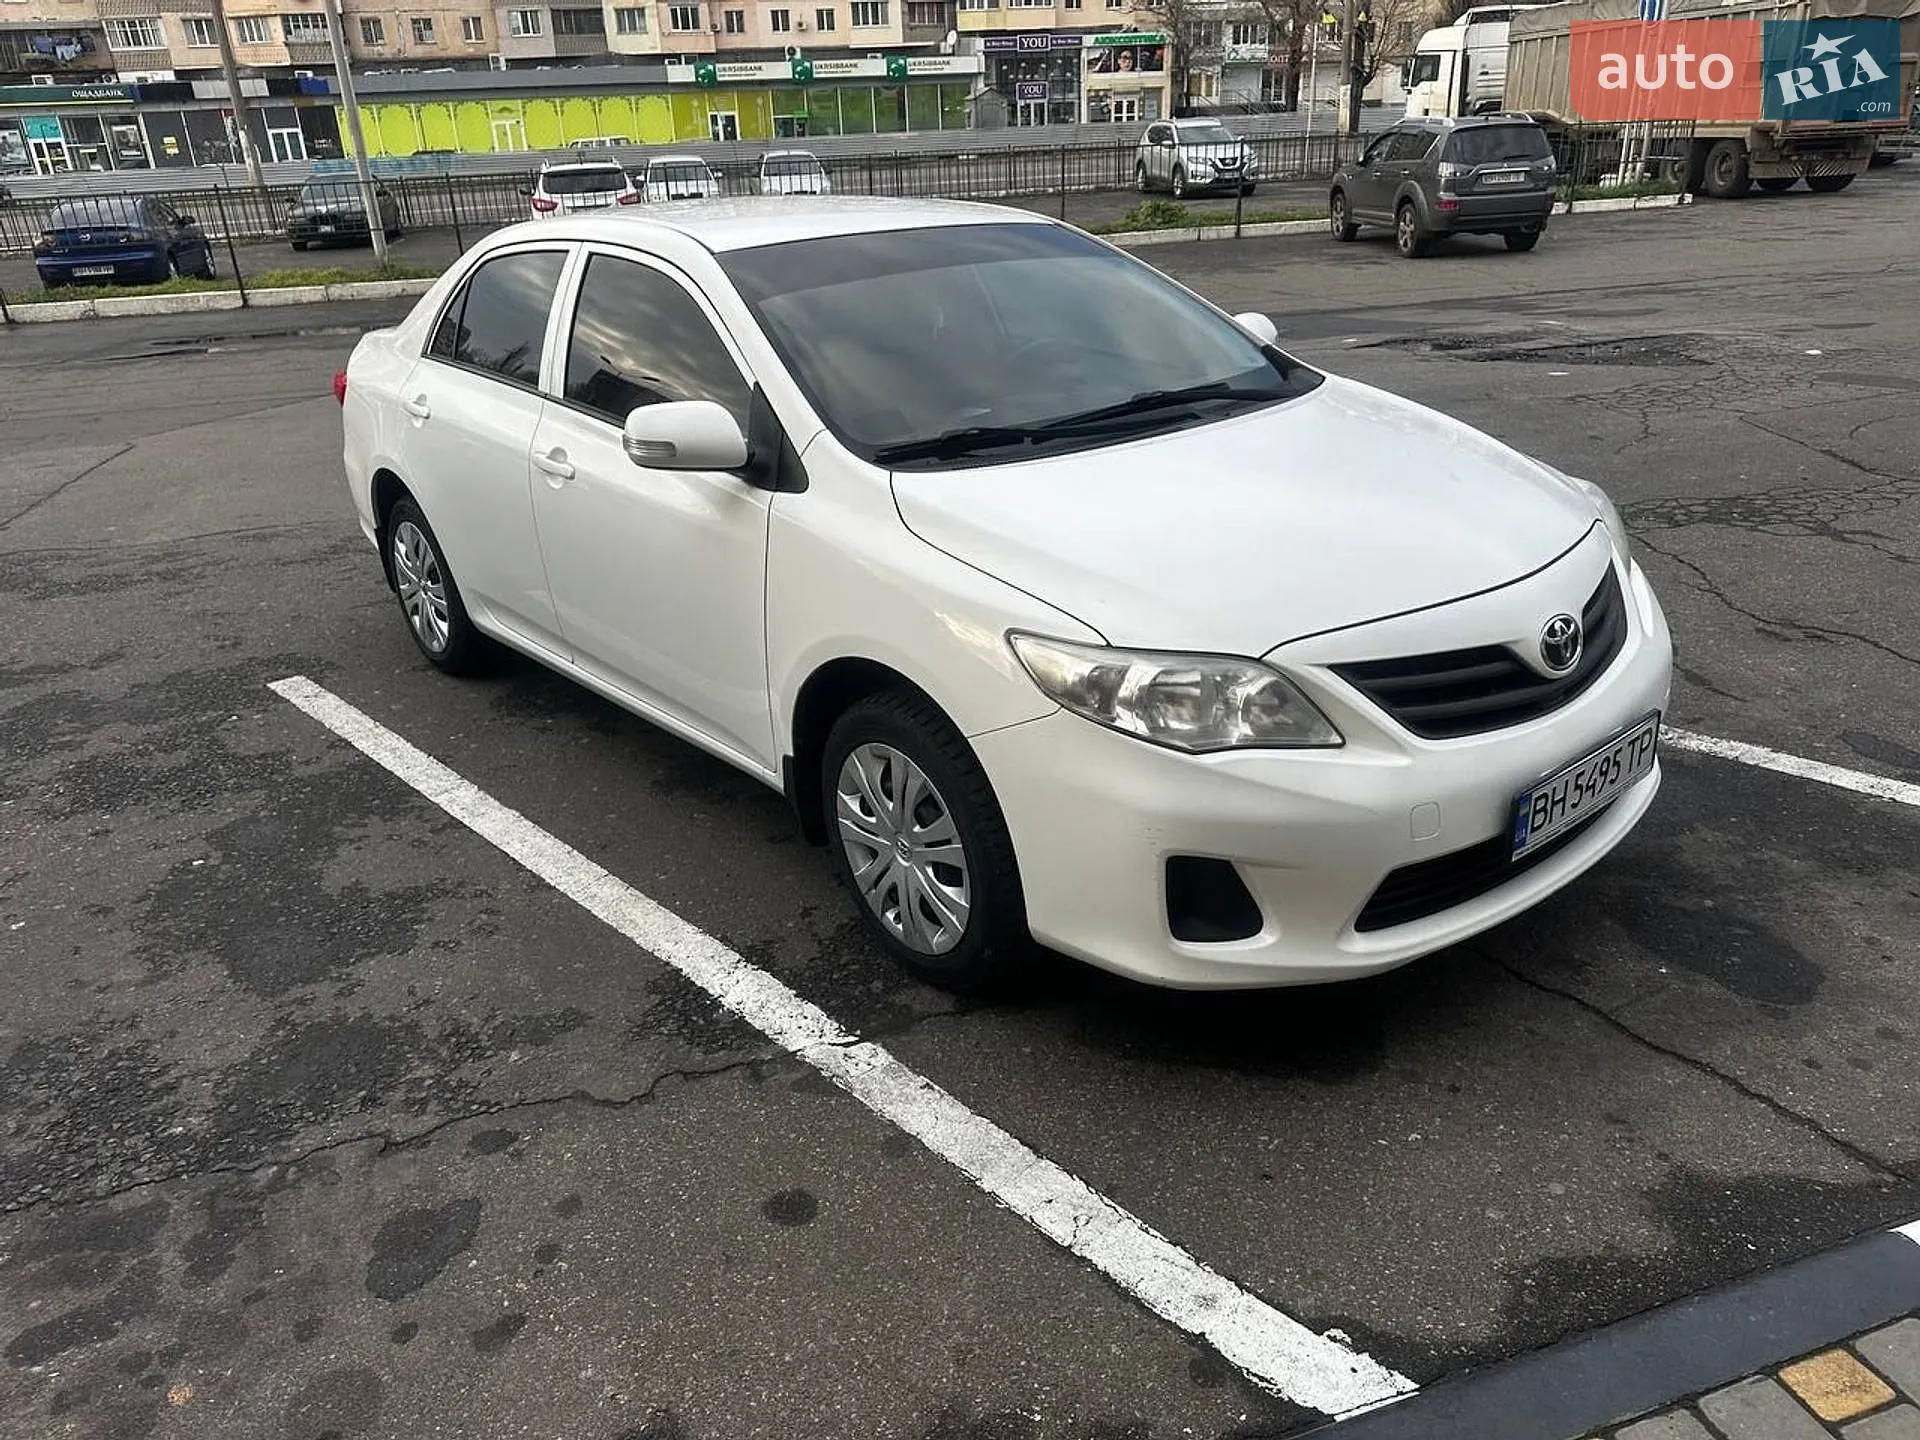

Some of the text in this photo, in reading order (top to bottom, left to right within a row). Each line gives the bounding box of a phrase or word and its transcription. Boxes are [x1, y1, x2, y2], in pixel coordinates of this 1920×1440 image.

[1020, 37, 1047, 48] YOU
[717, 65, 762, 73] UKRSIBBANK
[814, 62, 859, 70] UKRSIBBANK
[1022, 85, 1043, 94] YOU
[1530, 727, 1653, 834] BH 5495 TP
